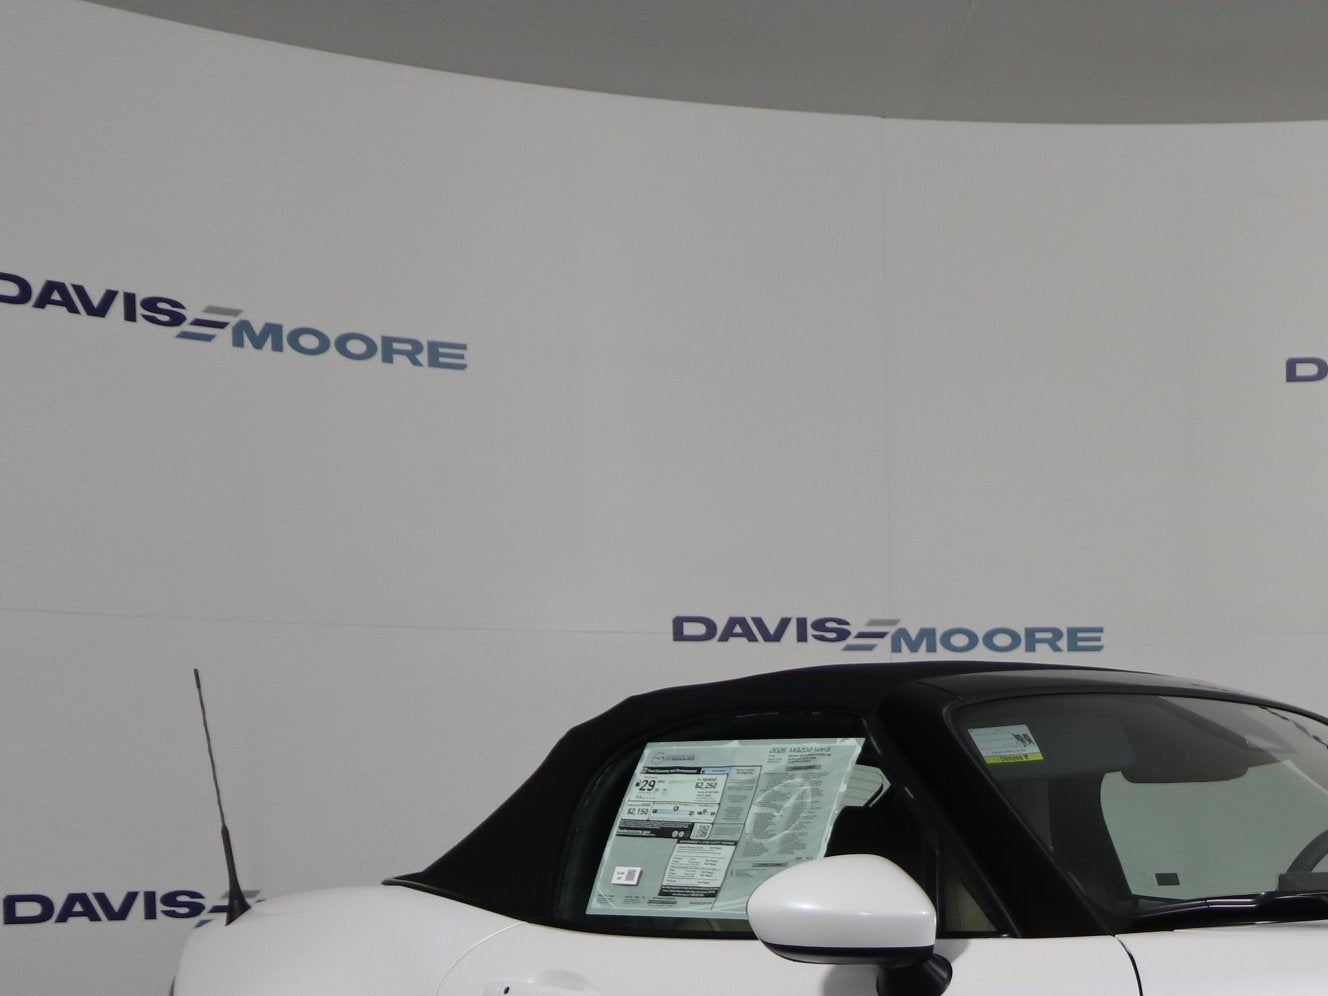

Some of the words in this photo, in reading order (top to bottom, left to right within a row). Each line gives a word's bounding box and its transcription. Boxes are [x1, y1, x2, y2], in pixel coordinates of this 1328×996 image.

[231, 319, 468, 370] MOORE
[672, 616, 851, 643] DAVIS
[890, 626, 1104, 653] MOORE
[639, 779, 656, 792] 29
[626, 807, 649, 816] $2,150
[3, 890, 206, 925] DAVIS
